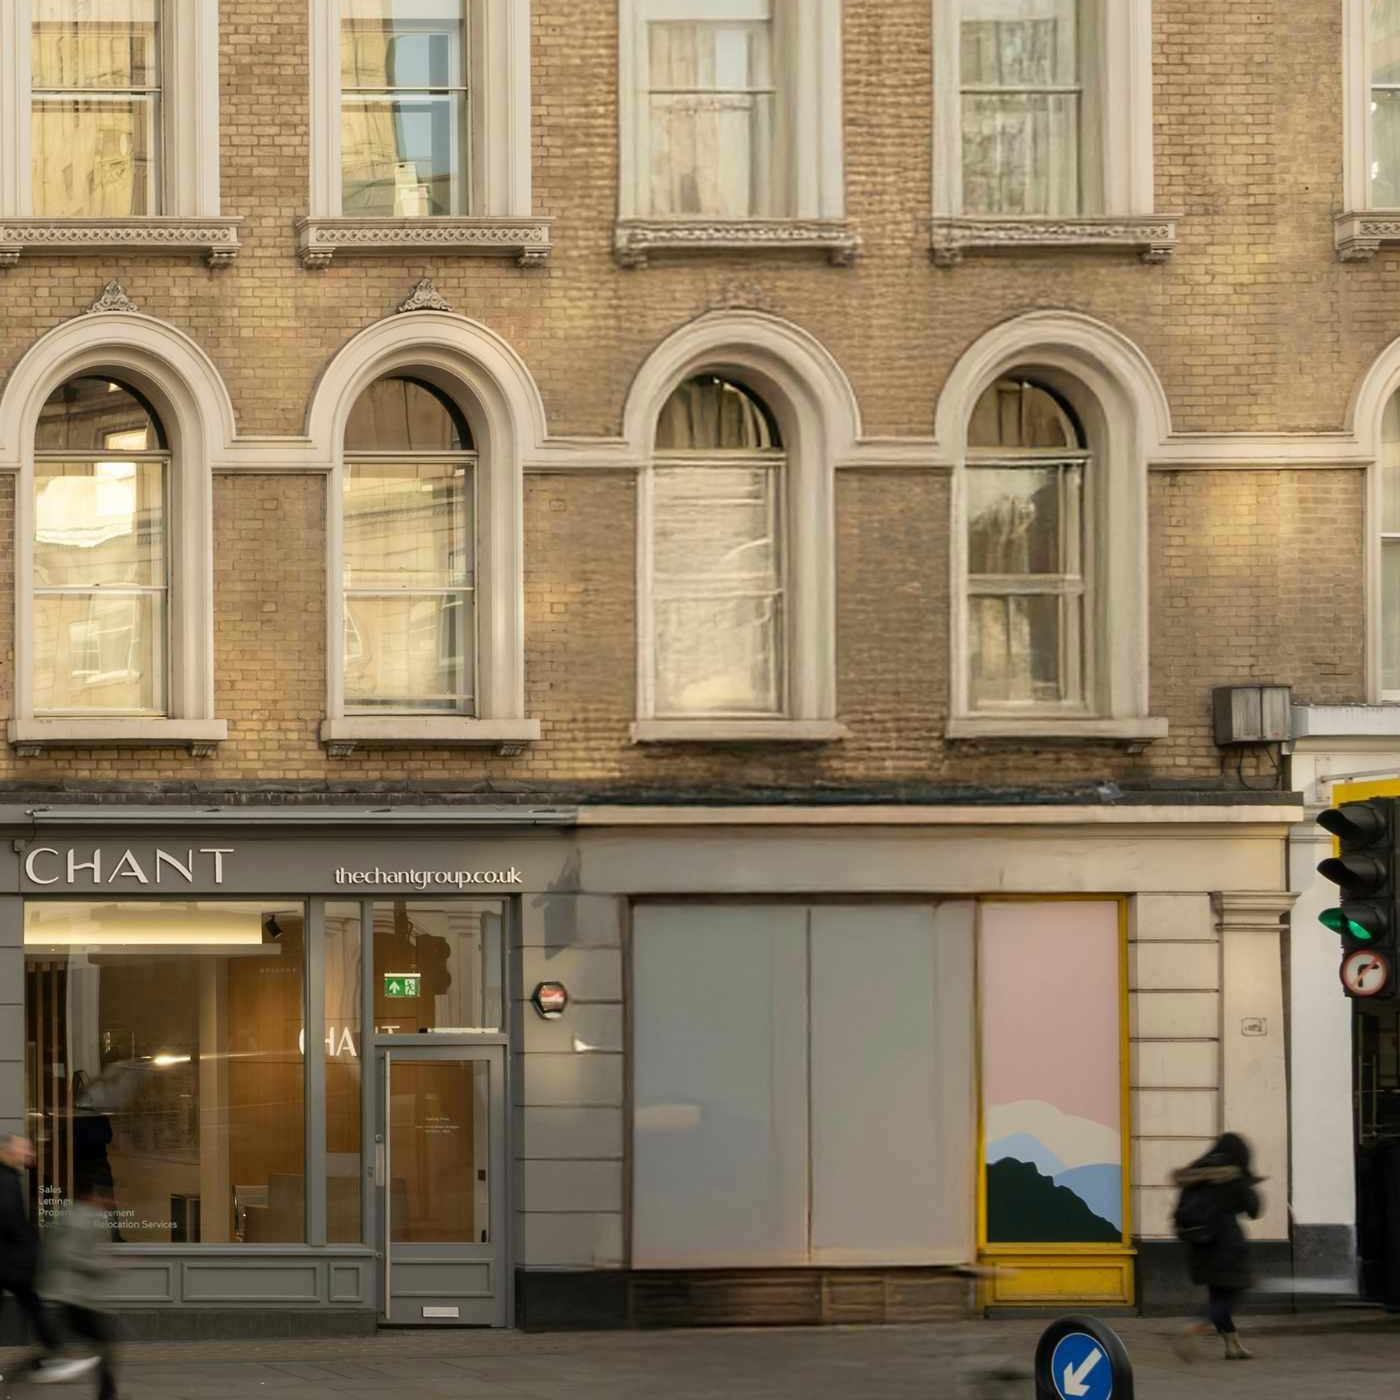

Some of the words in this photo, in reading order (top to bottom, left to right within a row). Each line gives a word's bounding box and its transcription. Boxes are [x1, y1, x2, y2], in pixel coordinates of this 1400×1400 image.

[25, 847, 235, 885] CHANT
[335, 866, 523, 890] thechantgroup.co.uk
[38, 1185, 62, 1194] Sales
[142, 1219, 178, 1230] Services
